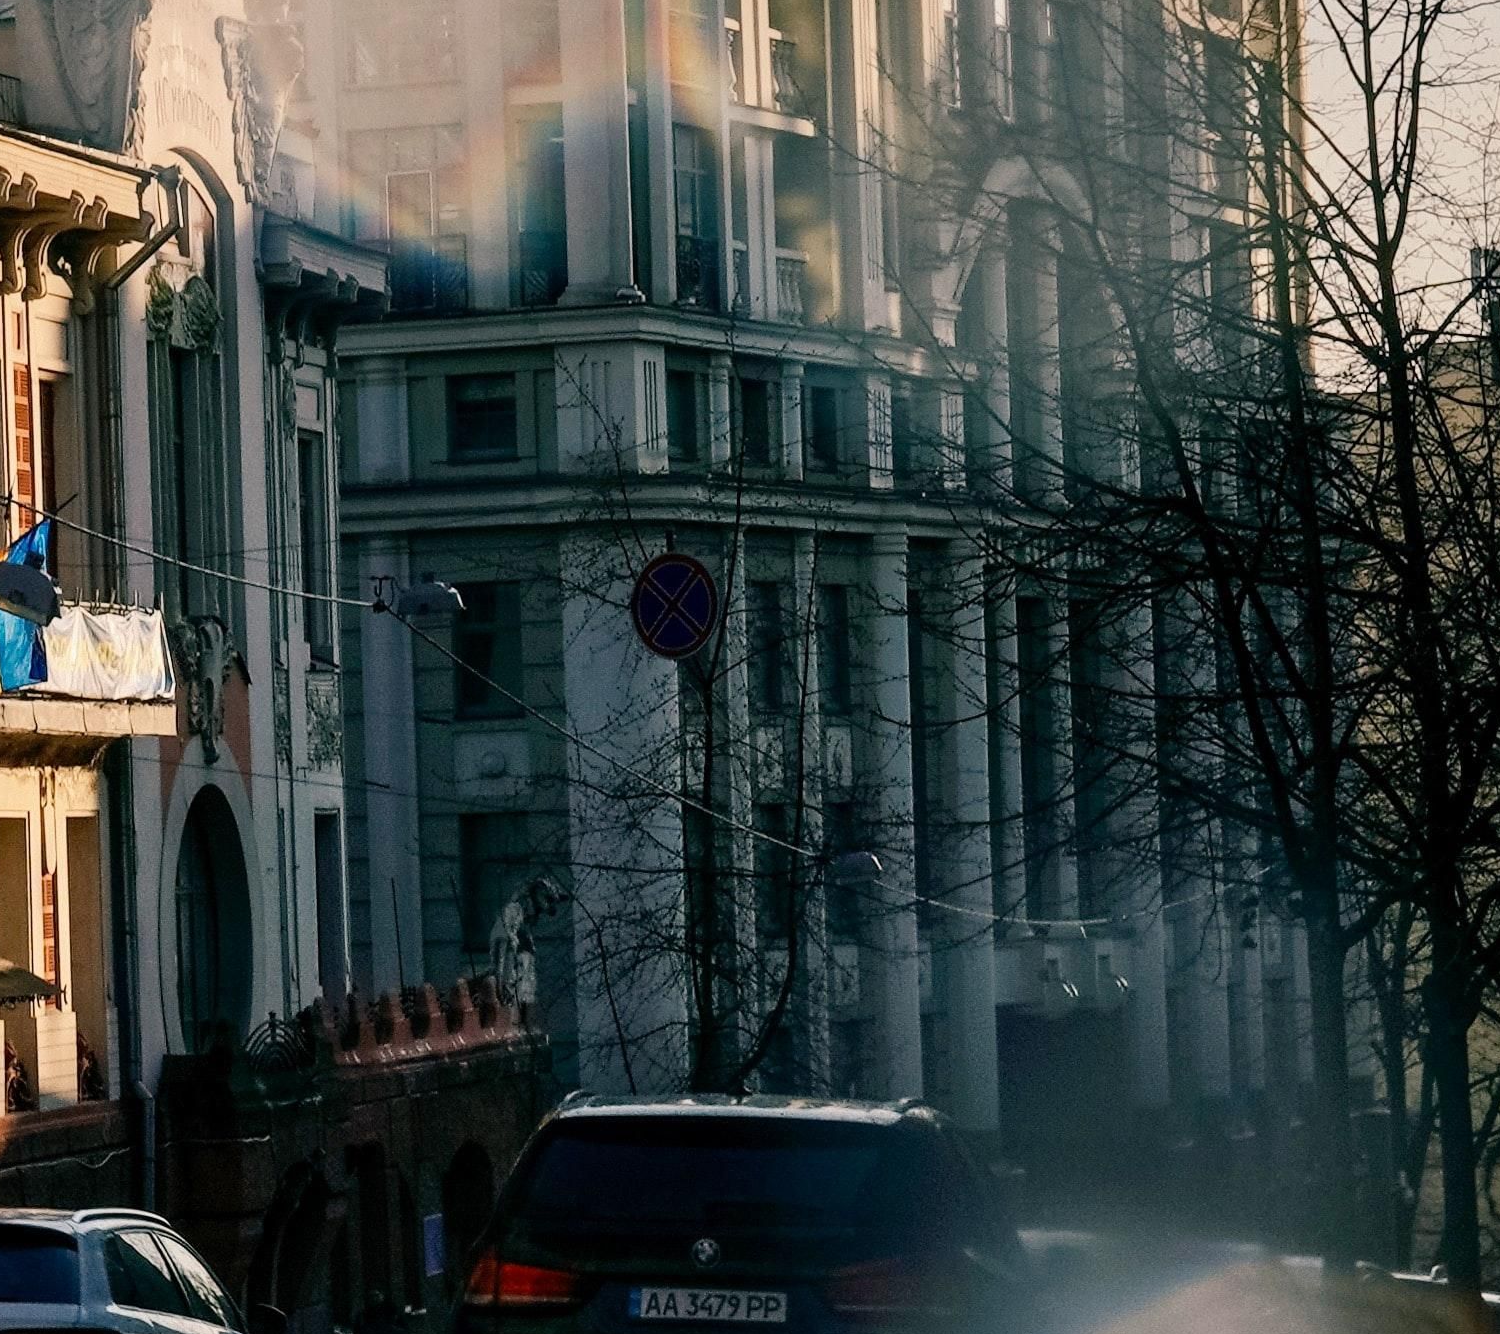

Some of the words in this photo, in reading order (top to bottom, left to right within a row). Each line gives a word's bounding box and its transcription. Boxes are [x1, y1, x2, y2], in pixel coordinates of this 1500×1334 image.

[645, 1292, 679, 1316] AA
[685, 1293, 741, 1318] 3479
[746, 1295, 781, 1319] PP
